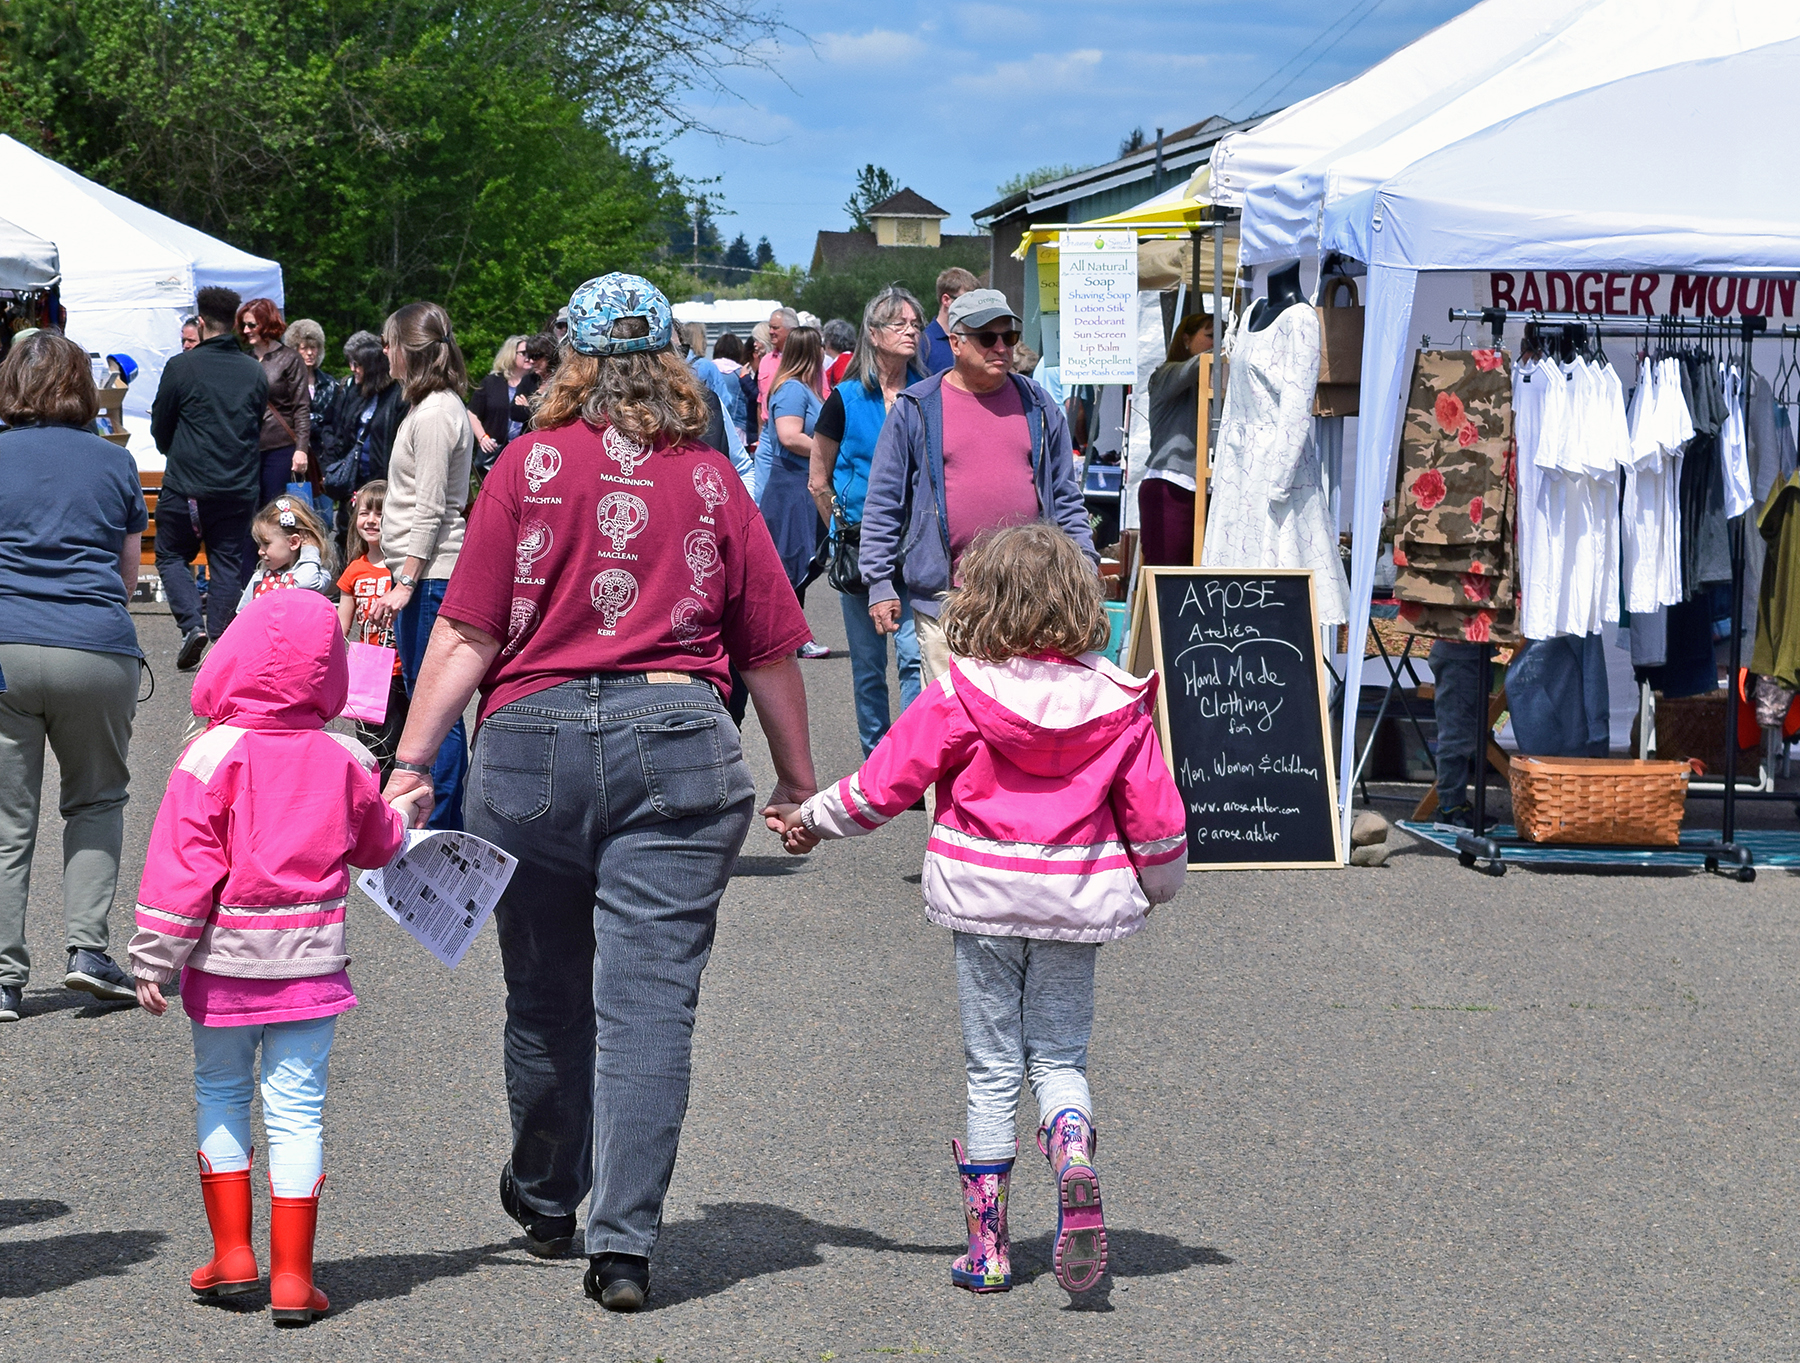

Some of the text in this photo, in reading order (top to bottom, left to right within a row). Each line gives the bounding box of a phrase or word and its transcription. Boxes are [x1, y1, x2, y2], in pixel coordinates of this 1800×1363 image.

[1070, 259, 1128, 271] All Natural
[1084, 277, 1115, 291] Soap
[1068, 289, 1131, 303] Shaving Soap
[1490, 271, 1660, 315] BADGER
[1074, 302, 1125, 312] Lotion Stik
[1074, 315, 1125, 325] Deodorant
[1080, 342, 1119, 355] Lip Balm
[1068, 355, 1132, 368] Bug Repellent
[1065, 369, 1090, 379] Diaper
[1091, 368, 1110, 376] Rash
[600, 473, 654, 487] MACKINNON
[597, 550, 638, 561] MACLEAN
[690, 585, 708, 599] SCOTT
[597, 628, 617, 636] KERR
[1184, 655, 1286, 697] Hand Made
[1200, 690, 1284, 732] Clothing
[1229, 718, 1253, 735] for
[1213, 752, 1254, 777] Women
